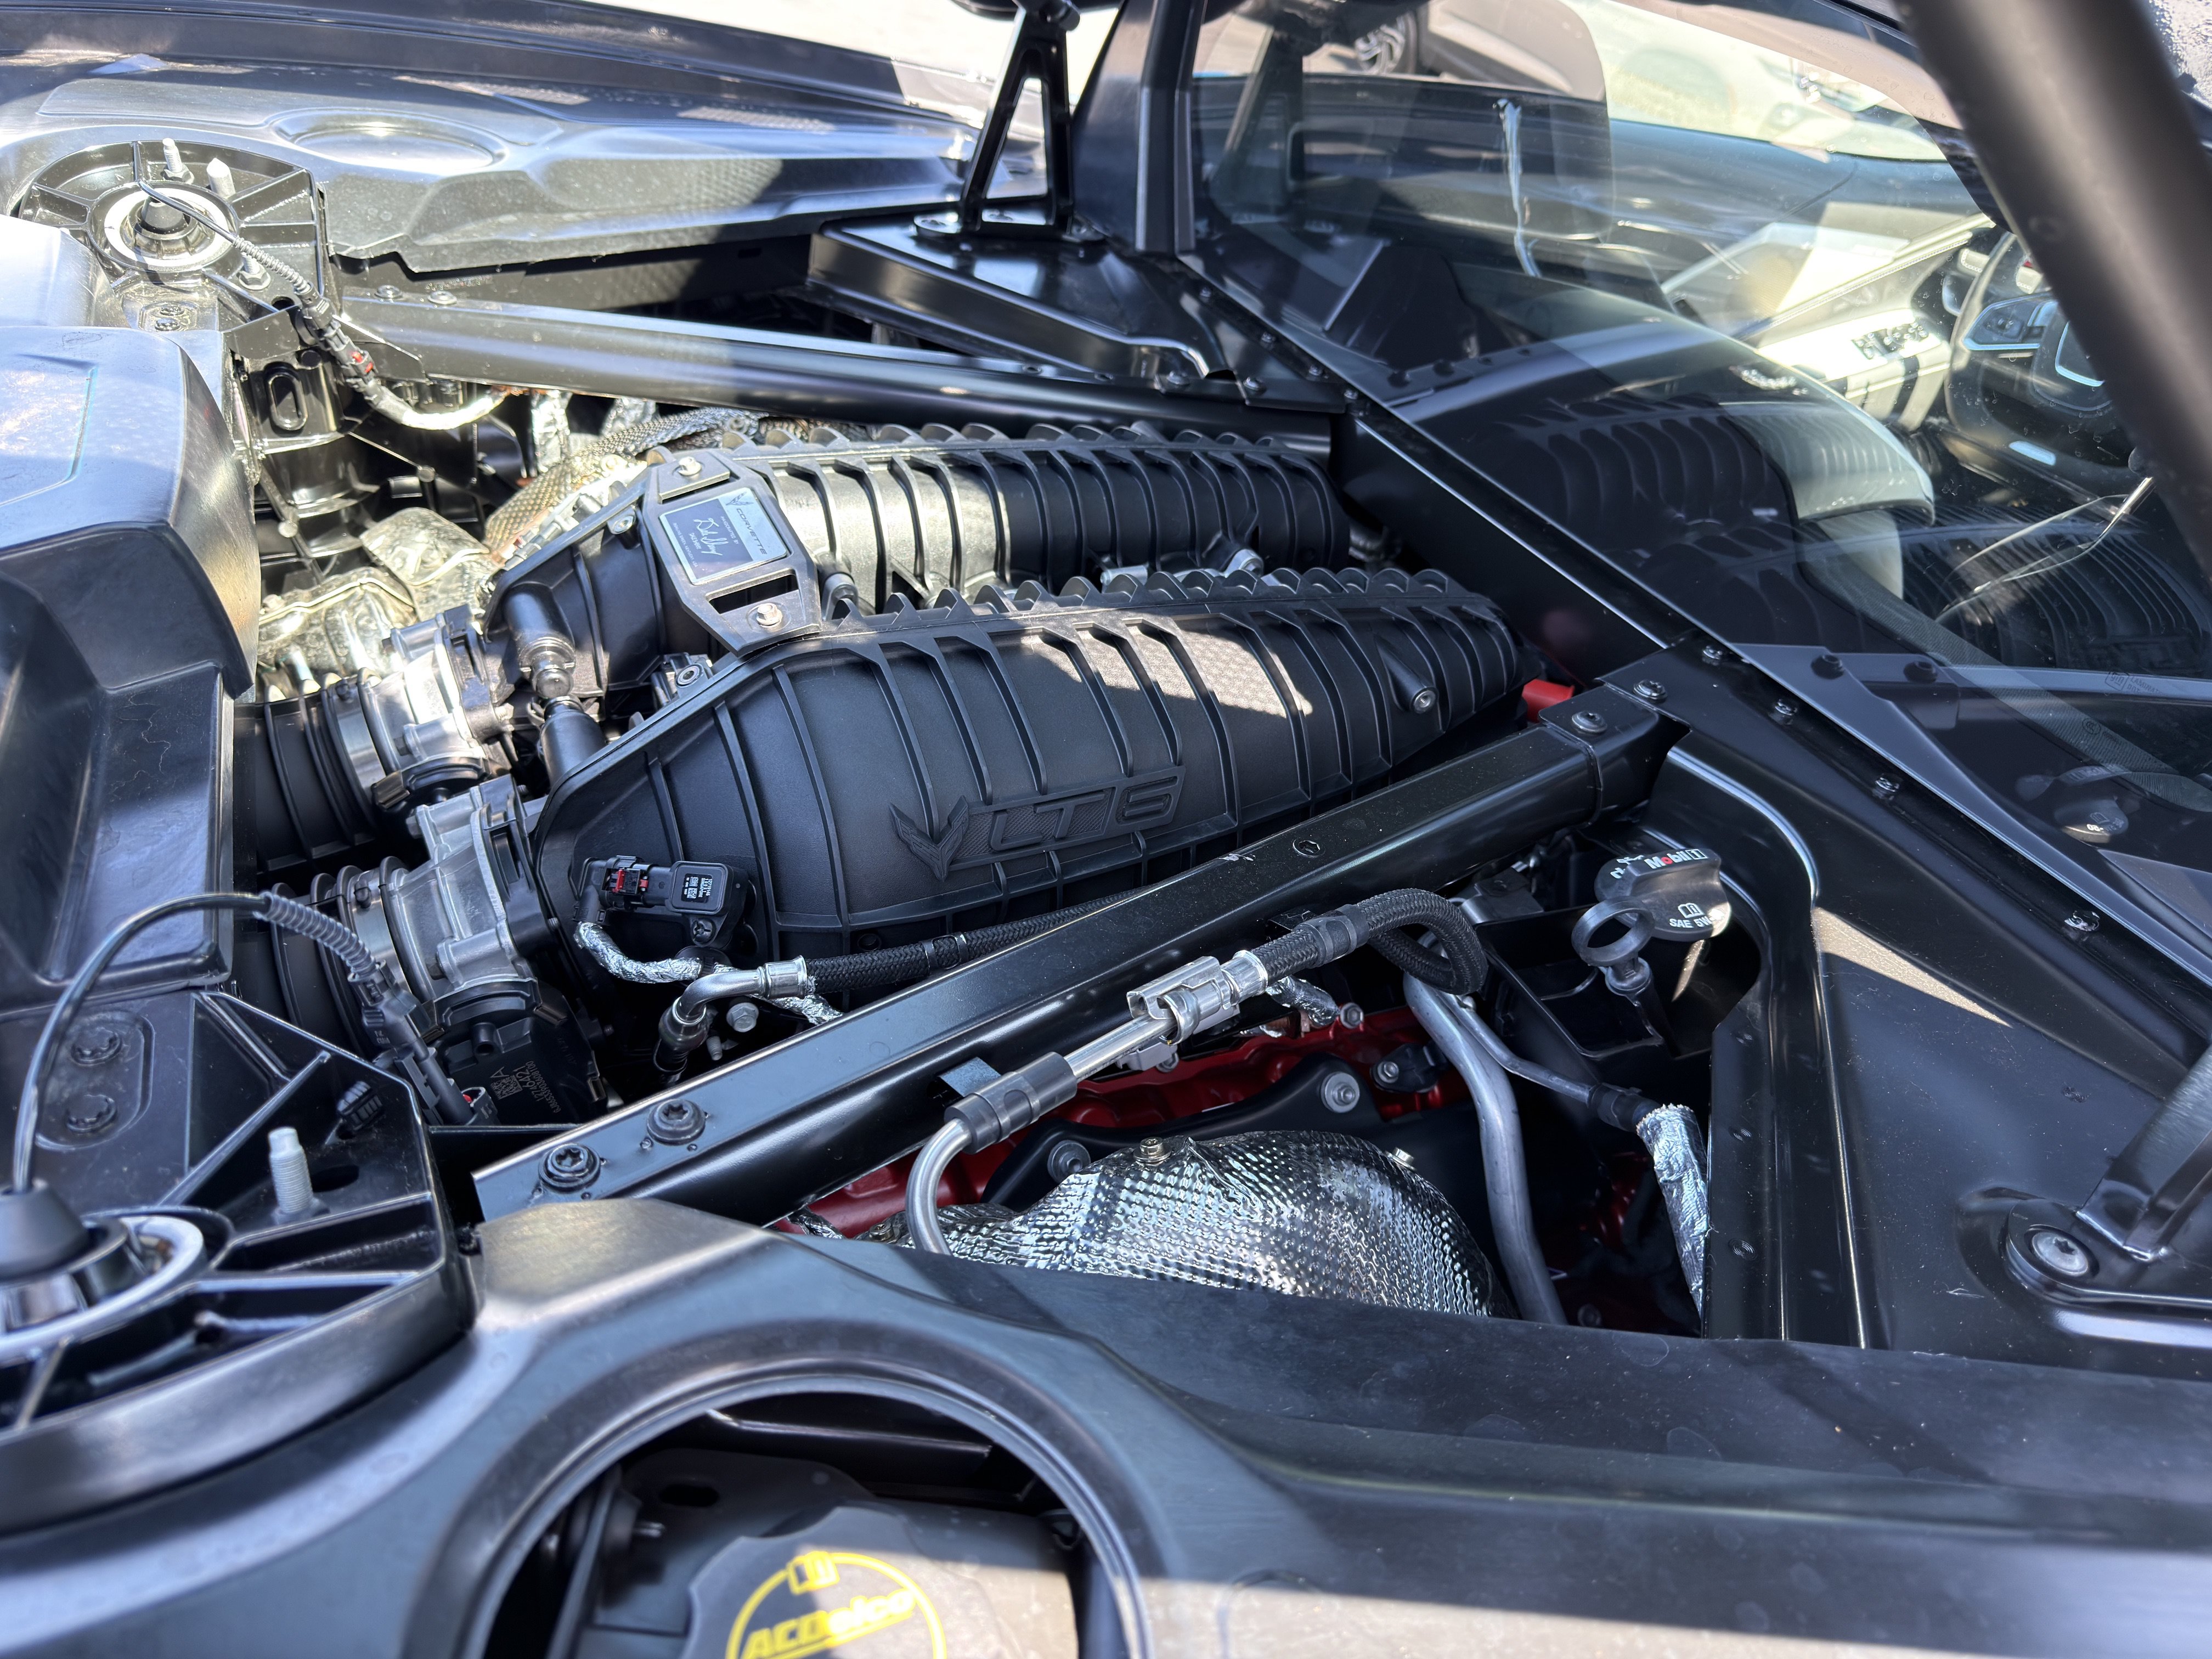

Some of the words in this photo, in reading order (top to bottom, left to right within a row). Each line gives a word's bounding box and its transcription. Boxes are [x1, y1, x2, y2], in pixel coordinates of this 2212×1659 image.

[720, 516, 736, 539] HANDCRAFTED
[736, 508, 767, 555] CORVETTE
[989, 775, 1181, 850] LT6
[1644, 851, 1692, 869] Mobil
[1669, 918, 1694, 928] SAE
[490, 1066, 510, 1079] A
[514, 1065, 545, 1102] 12746421
[742, 1588, 916, 1659] ACDelco
